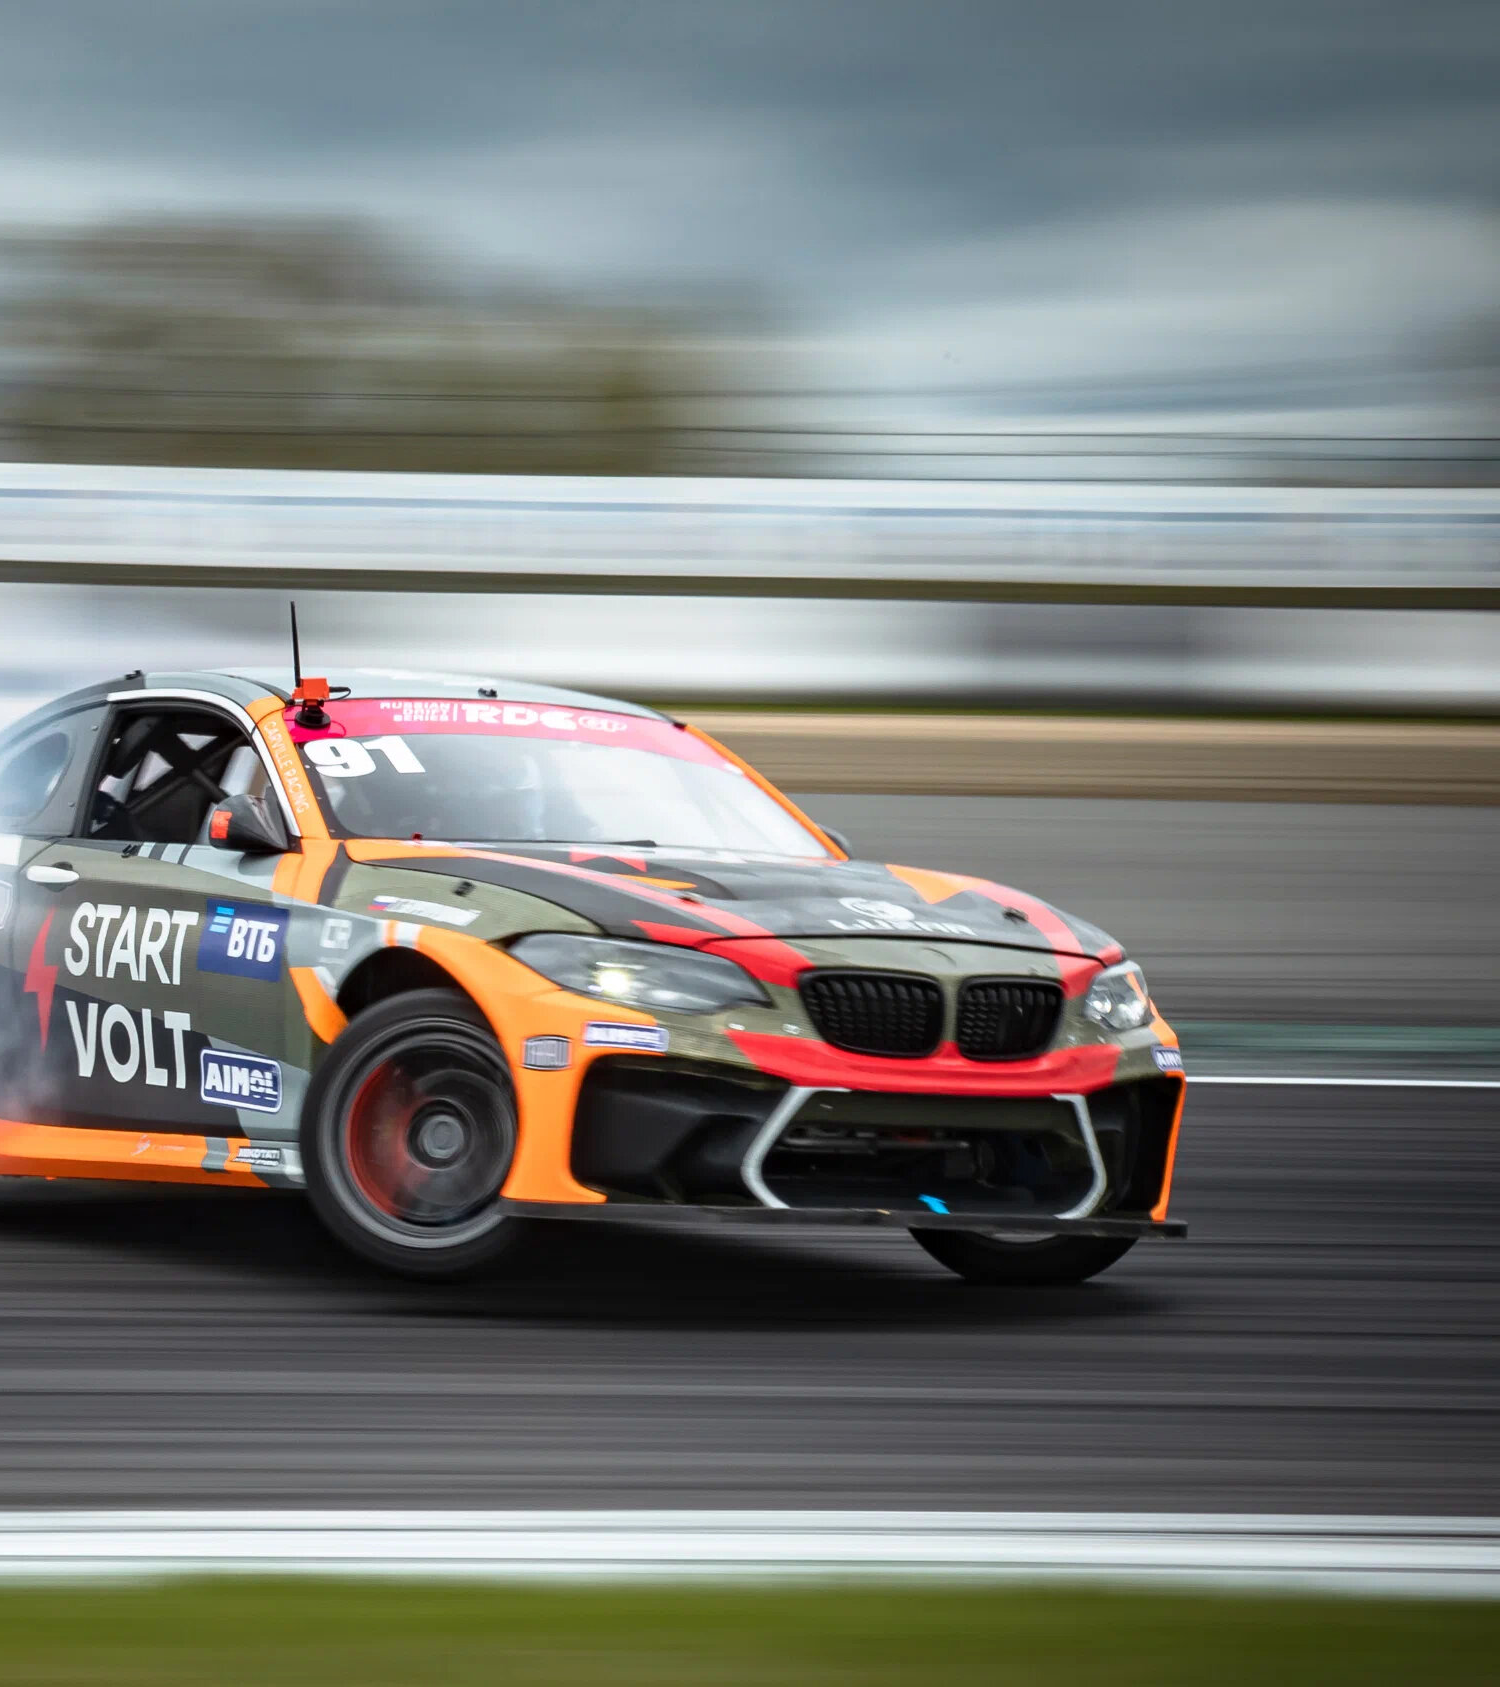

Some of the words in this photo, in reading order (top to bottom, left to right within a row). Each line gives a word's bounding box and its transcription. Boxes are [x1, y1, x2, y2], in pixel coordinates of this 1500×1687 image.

[380, 702, 450, 710] RUSSIAN
[393, 714, 449, 722] SERIES
[264, 721, 293, 769] CARVILLE
[284, 768, 310, 813] RACING
[304, 735, 426, 778] 91
[64, 902, 199, 985] START
[227, 918, 280, 963] ВТБ
[65, 1000, 191, 1089] VOLT
[205, 1062, 278, 1101] AIMOL
